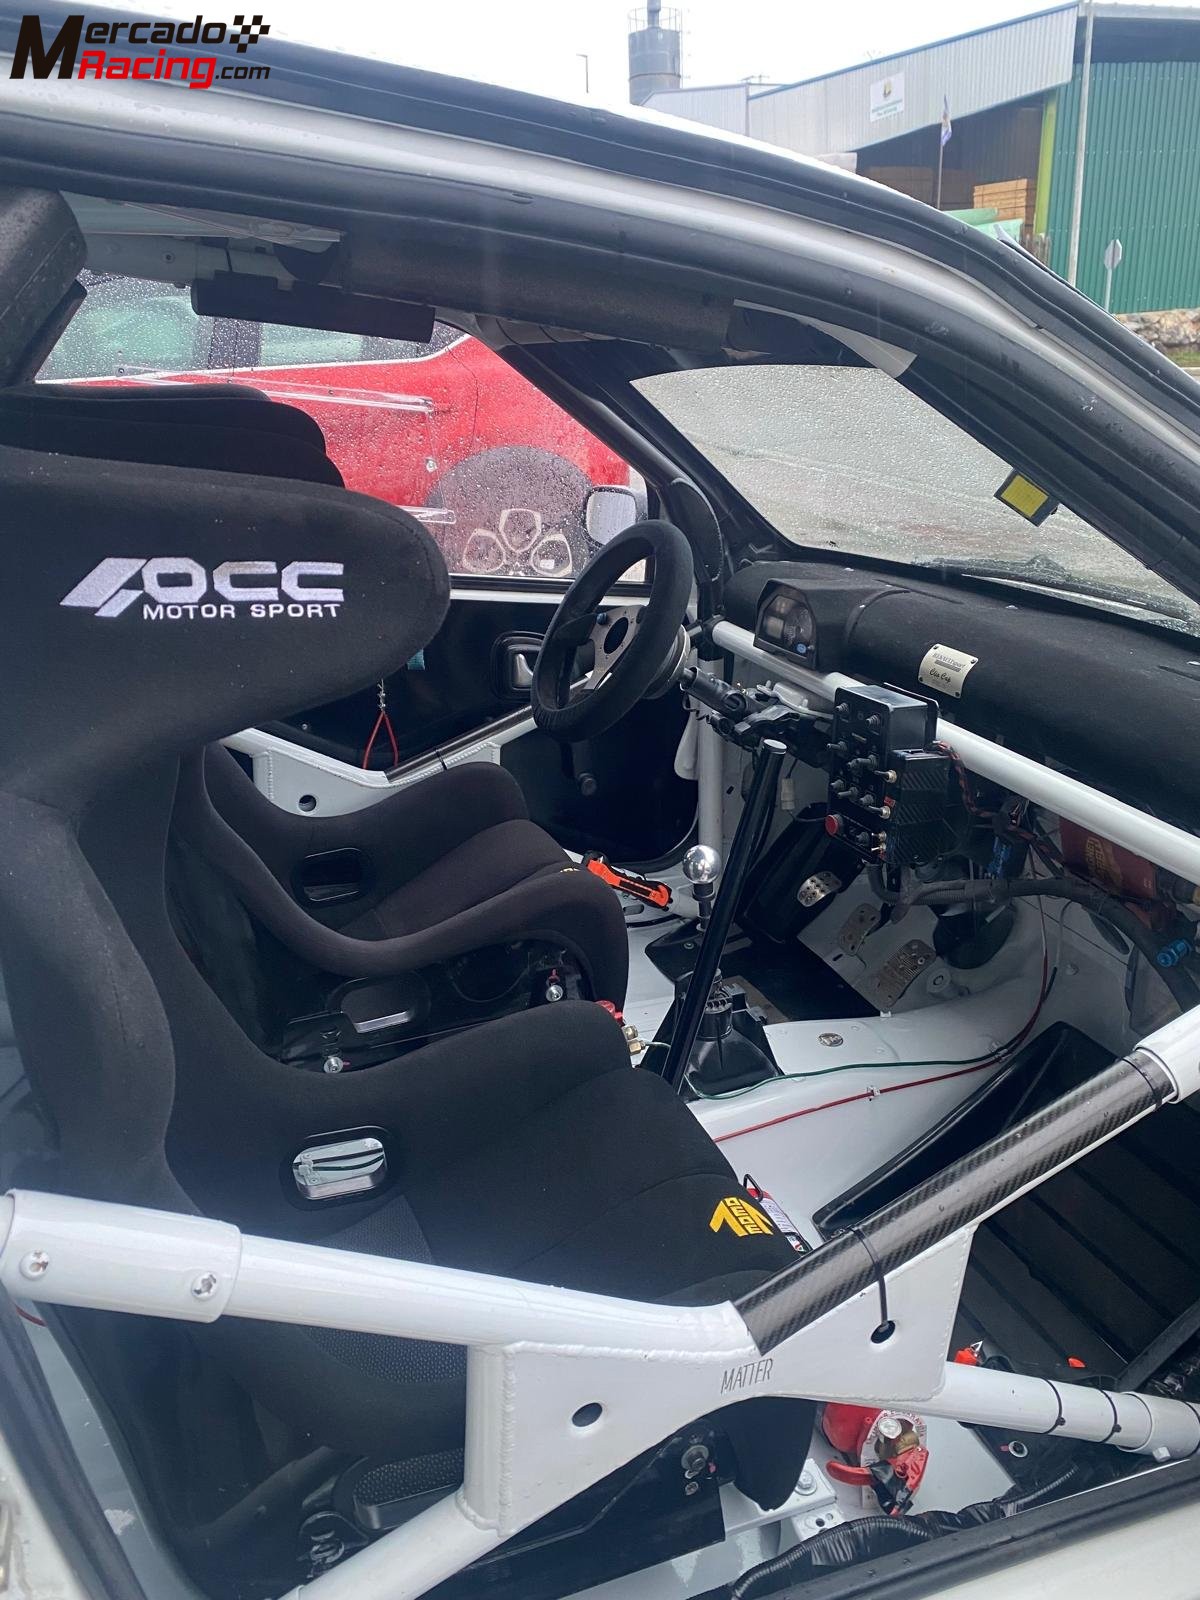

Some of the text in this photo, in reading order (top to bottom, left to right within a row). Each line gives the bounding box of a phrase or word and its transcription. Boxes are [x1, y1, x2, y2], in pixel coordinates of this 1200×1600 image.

[143, 603, 341, 620] MOTOR SPORT
[720, 1358, 773, 1395] MATTER
